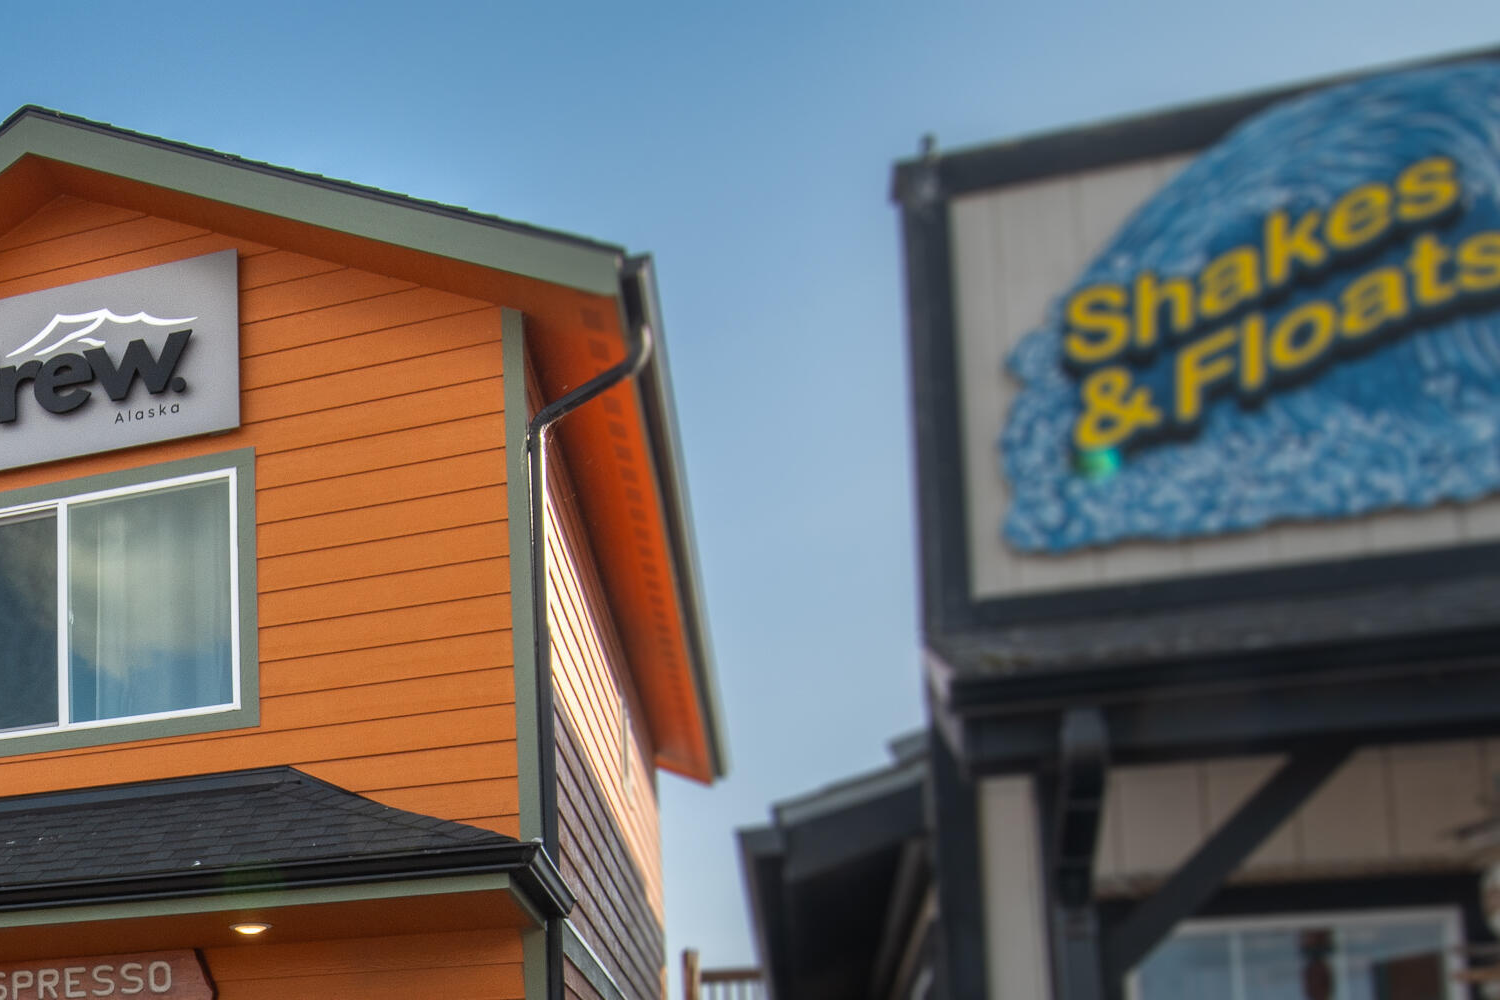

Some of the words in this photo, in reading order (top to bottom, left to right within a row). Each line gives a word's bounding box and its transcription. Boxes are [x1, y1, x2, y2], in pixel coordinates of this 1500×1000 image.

[1065, 157, 1459, 362] Shakes
[1074, 366, 1161, 449] &
[1175, 229, 1500, 422] Floats
[114, 402, 181, 425] Alaska
